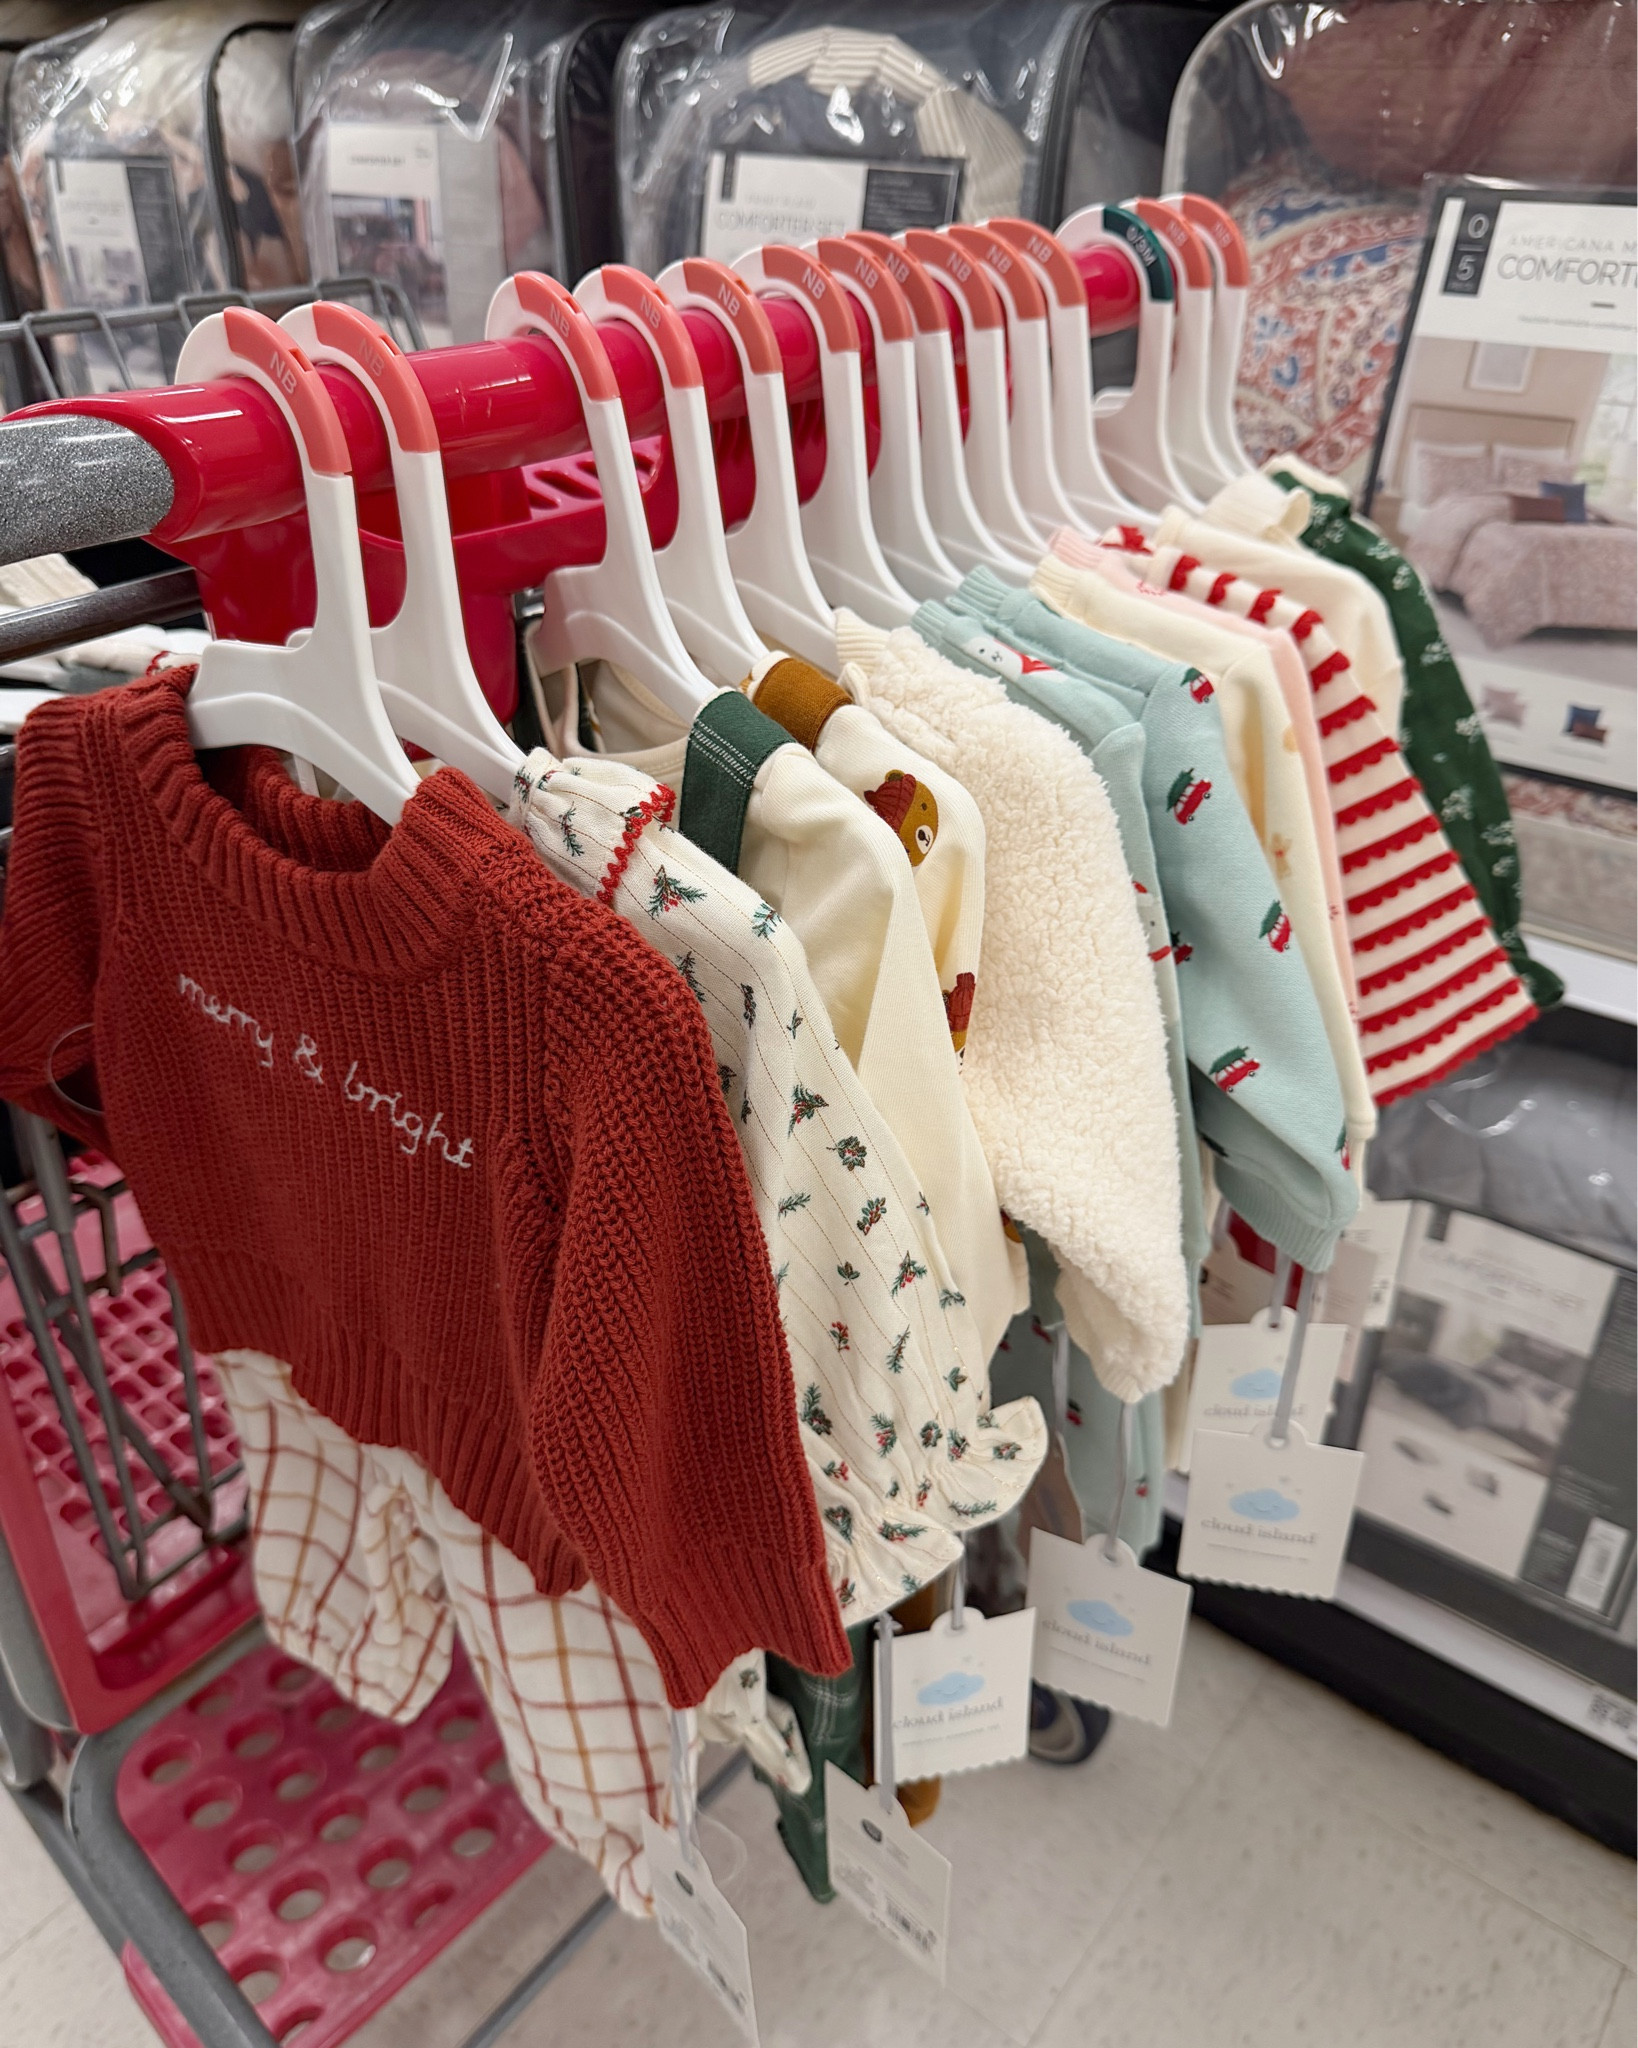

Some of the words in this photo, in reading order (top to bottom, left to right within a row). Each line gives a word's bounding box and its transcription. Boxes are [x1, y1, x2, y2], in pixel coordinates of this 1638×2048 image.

[986, 244, 1014, 275] NB
[1027, 235, 1054, 264] NB
[802, 266, 826, 300] NB
[854, 257, 879, 289] NB
[885, 252, 910, 283] NB
[946, 252, 973, 283] NB
[1455, 254, 1478, 281] 5
[1497, 252, 1637, 287] COMFORT
[640, 294, 662, 329] NB
[717, 283, 741, 317] NB
[549, 303, 571, 338] NB
[269, 351, 298, 395] NB
[359, 336, 386, 377] NB
[178, 973, 274, 1068] merry
[293, 1033, 324, 1085] &
[343, 1060, 475, 1169] bright
[1201, 1516, 1252, 1536] cloud
[1257, 1525, 1319, 1545] island
